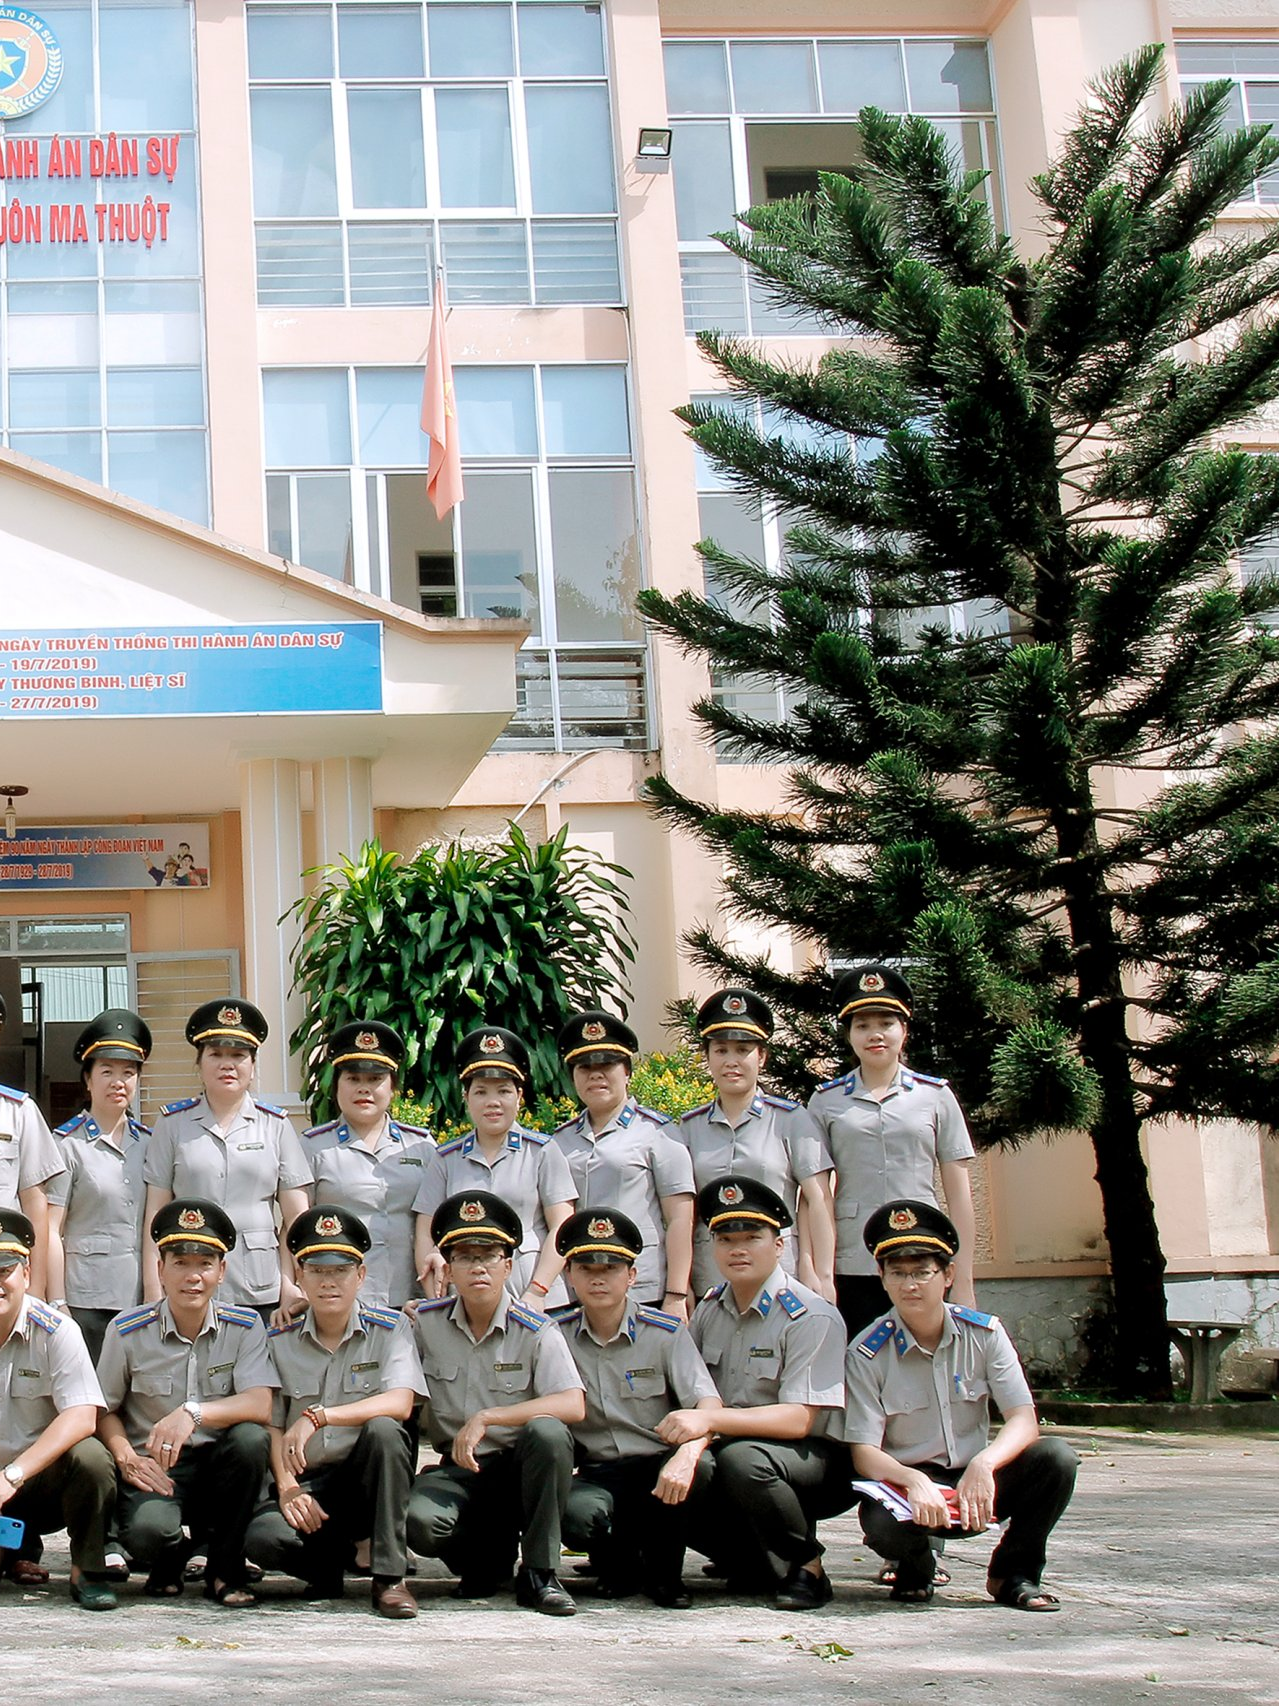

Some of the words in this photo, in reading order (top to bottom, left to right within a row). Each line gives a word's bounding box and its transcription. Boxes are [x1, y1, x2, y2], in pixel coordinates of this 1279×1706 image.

[17, 10, 44, 32] DÂN
[48, 134, 82, 178] ÁN
[90, 132, 138, 178] DÂN
[147, 134, 180, 182] SỰ
[50, 204, 89, 244] MA
[94, 196, 171, 249] THUỘT
[114, 633, 167, 650] THỐNG
[173, 637, 197, 649] THI
[202, 633, 247, 648] HÀNH
[253, 632, 275, 647] ÁN
[280, 632, 314, 647] DÂN
[319, 632, 344, 649] SỰ
[11, 658, 97, 671] 19/7/2019)
[11, 676, 76, 690] THƯƠNG
[81, 676, 125, 689] BINH,
[130, 674, 163, 690] LIỆT
[168, 673, 185, 687] SĨ
[11, 697, 98, 710] 27/7/2019)
[10, 841, 19, 855] 90
[20, 837, 37, 855] NĂM
[37, 837, 56, 855] NGÀY
[56, 836, 79, 855] THÀNH
[94, 836, 112, 854] CÔNG
[132, 837, 148, 855] VIỆT
[148, 839, 164, 853] NAM
